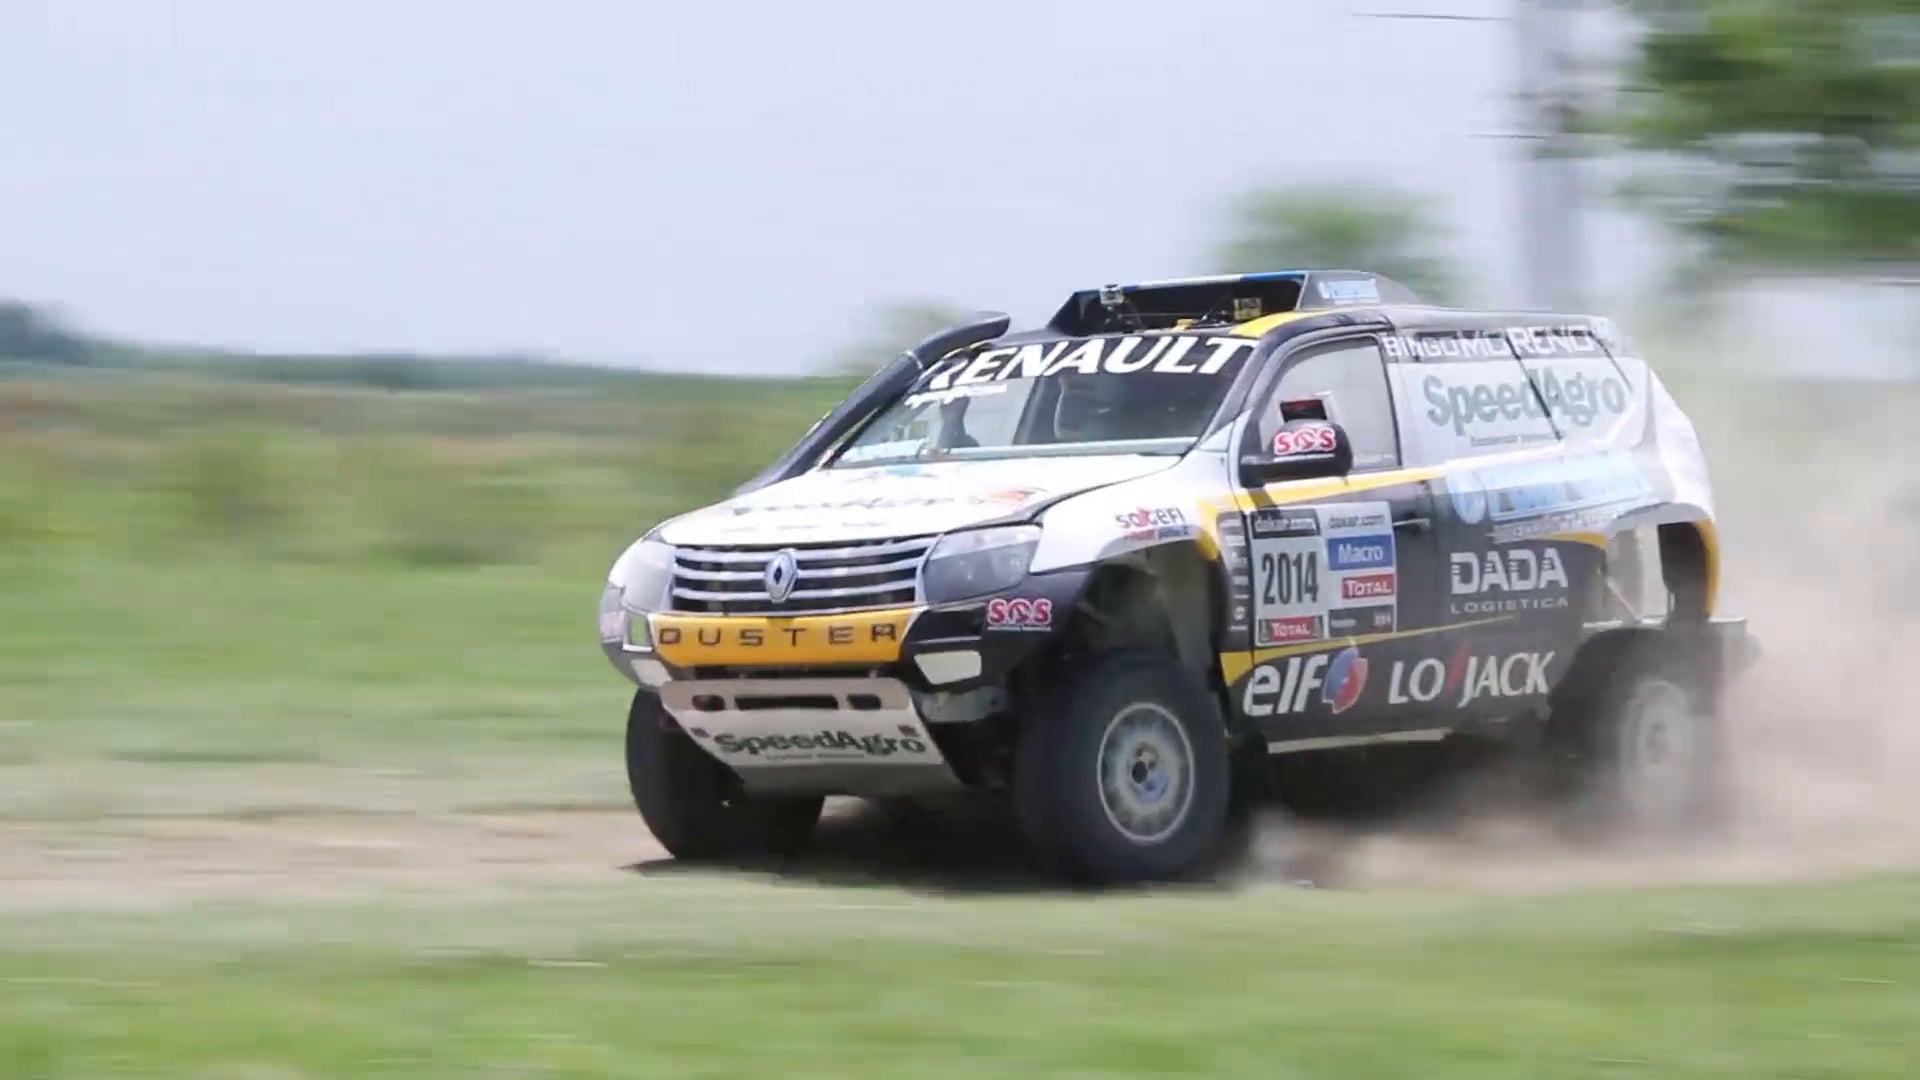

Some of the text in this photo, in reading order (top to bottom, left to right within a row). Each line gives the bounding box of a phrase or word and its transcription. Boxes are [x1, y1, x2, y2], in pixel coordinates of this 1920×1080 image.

[1422, 367, 1626, 436] SpeedAgro
[1274, 427, 1336, 455] SOS
[1337, 543, 1384, 564] Macro
[1261, 551, 1319, 605] 2014
[1450, 547, 1569, 595] DADA
[1345, 579, 1392, 597] TOTAL
[987, 598, 1052, 625] SOS
[1450, 597, 1569, 615] LOGISTICA
[658, 622, 898, 647] DUSTER
[1271, 621, 1311, 637] TOTAL
[1241, 654, 1329, 716] elf
[713, 730, 927, 756] SpeedAgro
